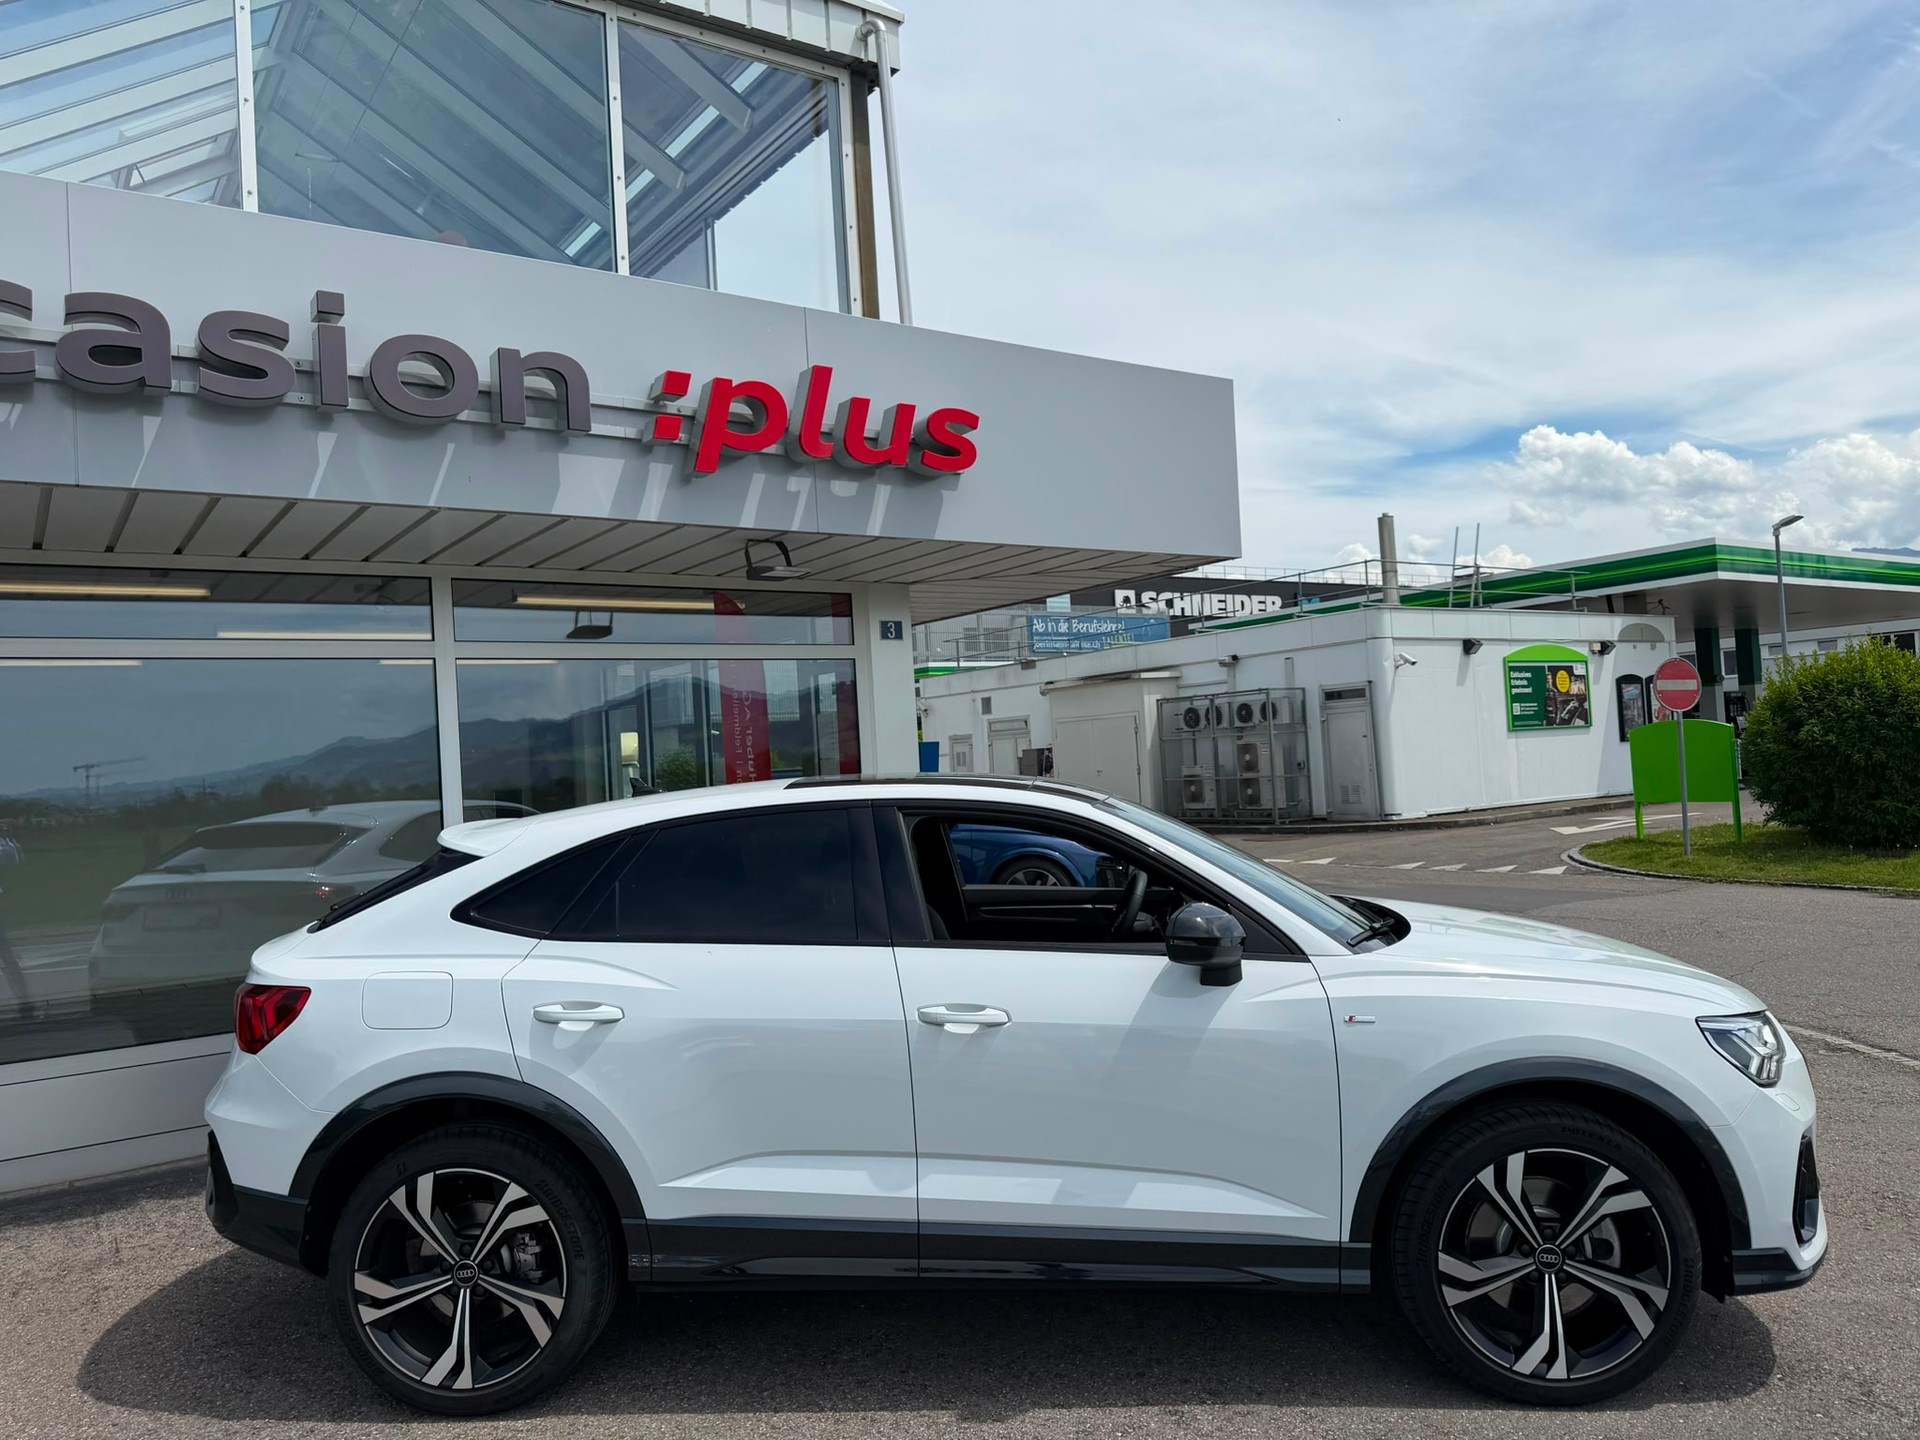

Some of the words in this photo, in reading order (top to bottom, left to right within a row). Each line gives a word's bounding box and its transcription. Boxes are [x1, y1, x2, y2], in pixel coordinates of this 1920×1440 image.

[1141, 590, 1283, 617] SCHNEIDER
[886, 622, 896, 639] 3
[1032, 618, 1046, 633] Ab
[1047, 618, 1057, 633] in
[1057, 618, 1069, 633] die
[533, 1178, 586, 1262] BRIDGESTONE
